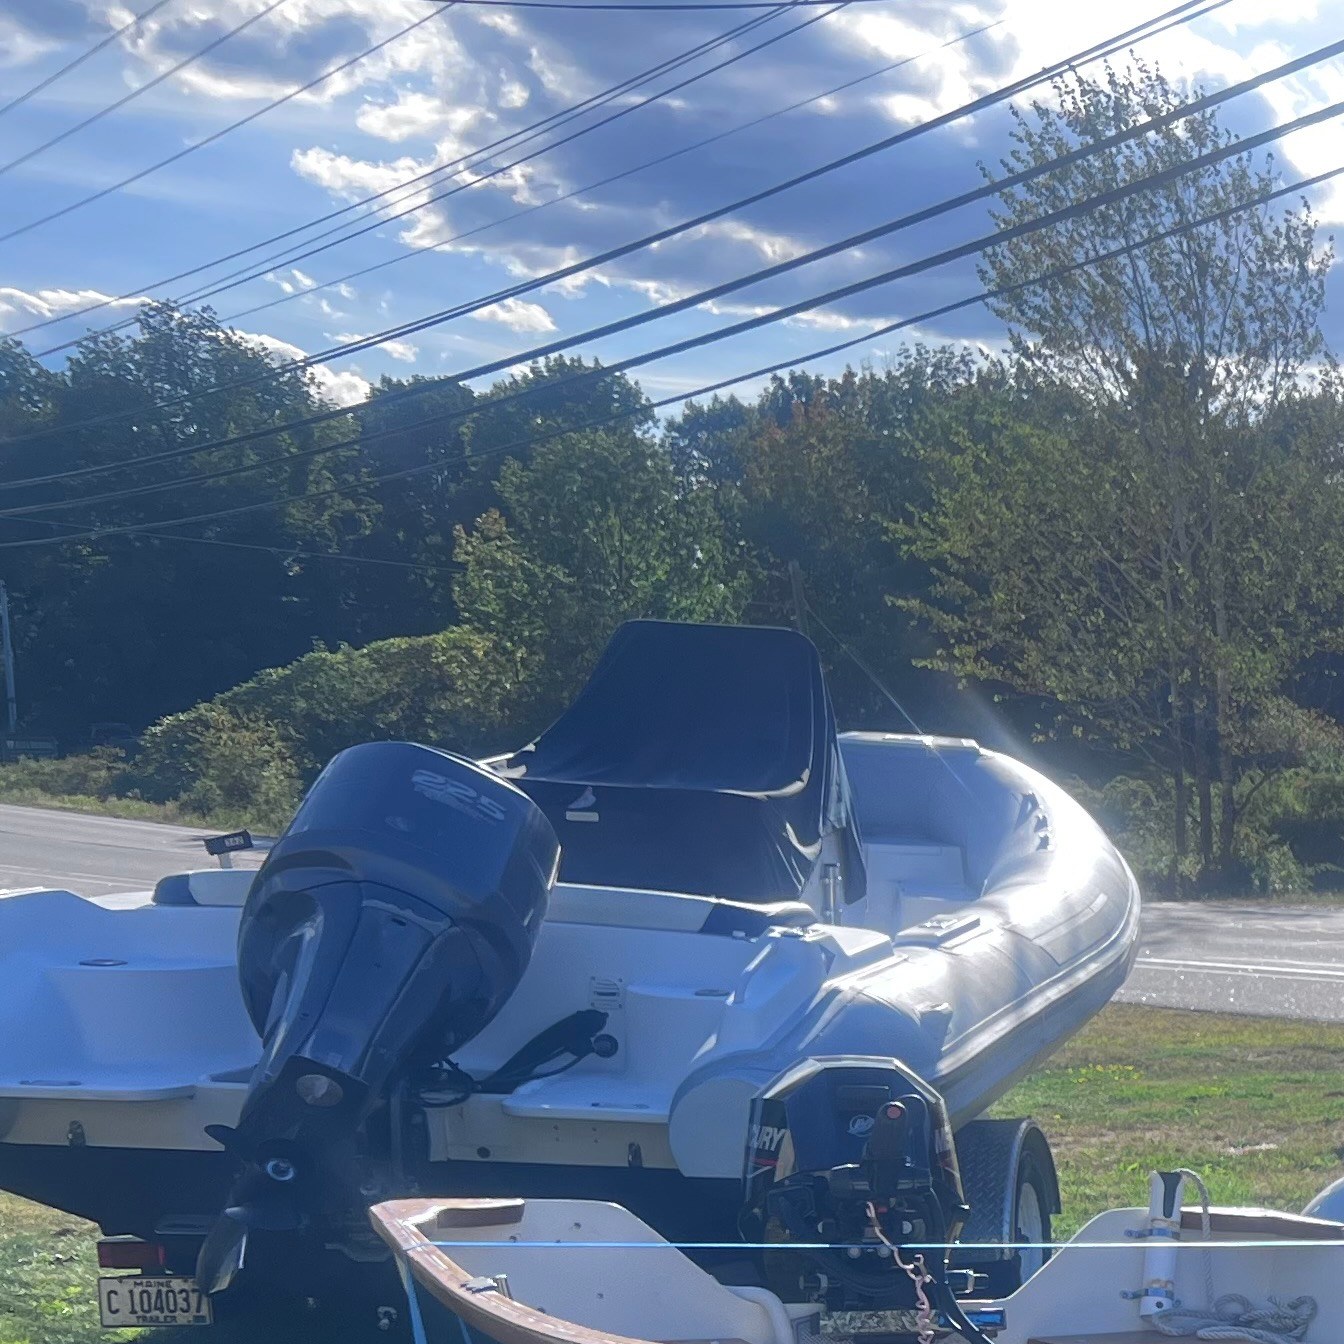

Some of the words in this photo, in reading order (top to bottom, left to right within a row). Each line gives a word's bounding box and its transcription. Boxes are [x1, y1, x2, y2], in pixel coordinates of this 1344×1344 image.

[410, 769, 507, 820] 225
[133, 1280, 173, 1289] MAINE
[107, 1289, 120, 1315] C
[128, 1288, 204, 1315] 104037
[135, 1315, 178, 1324] TRAILER
